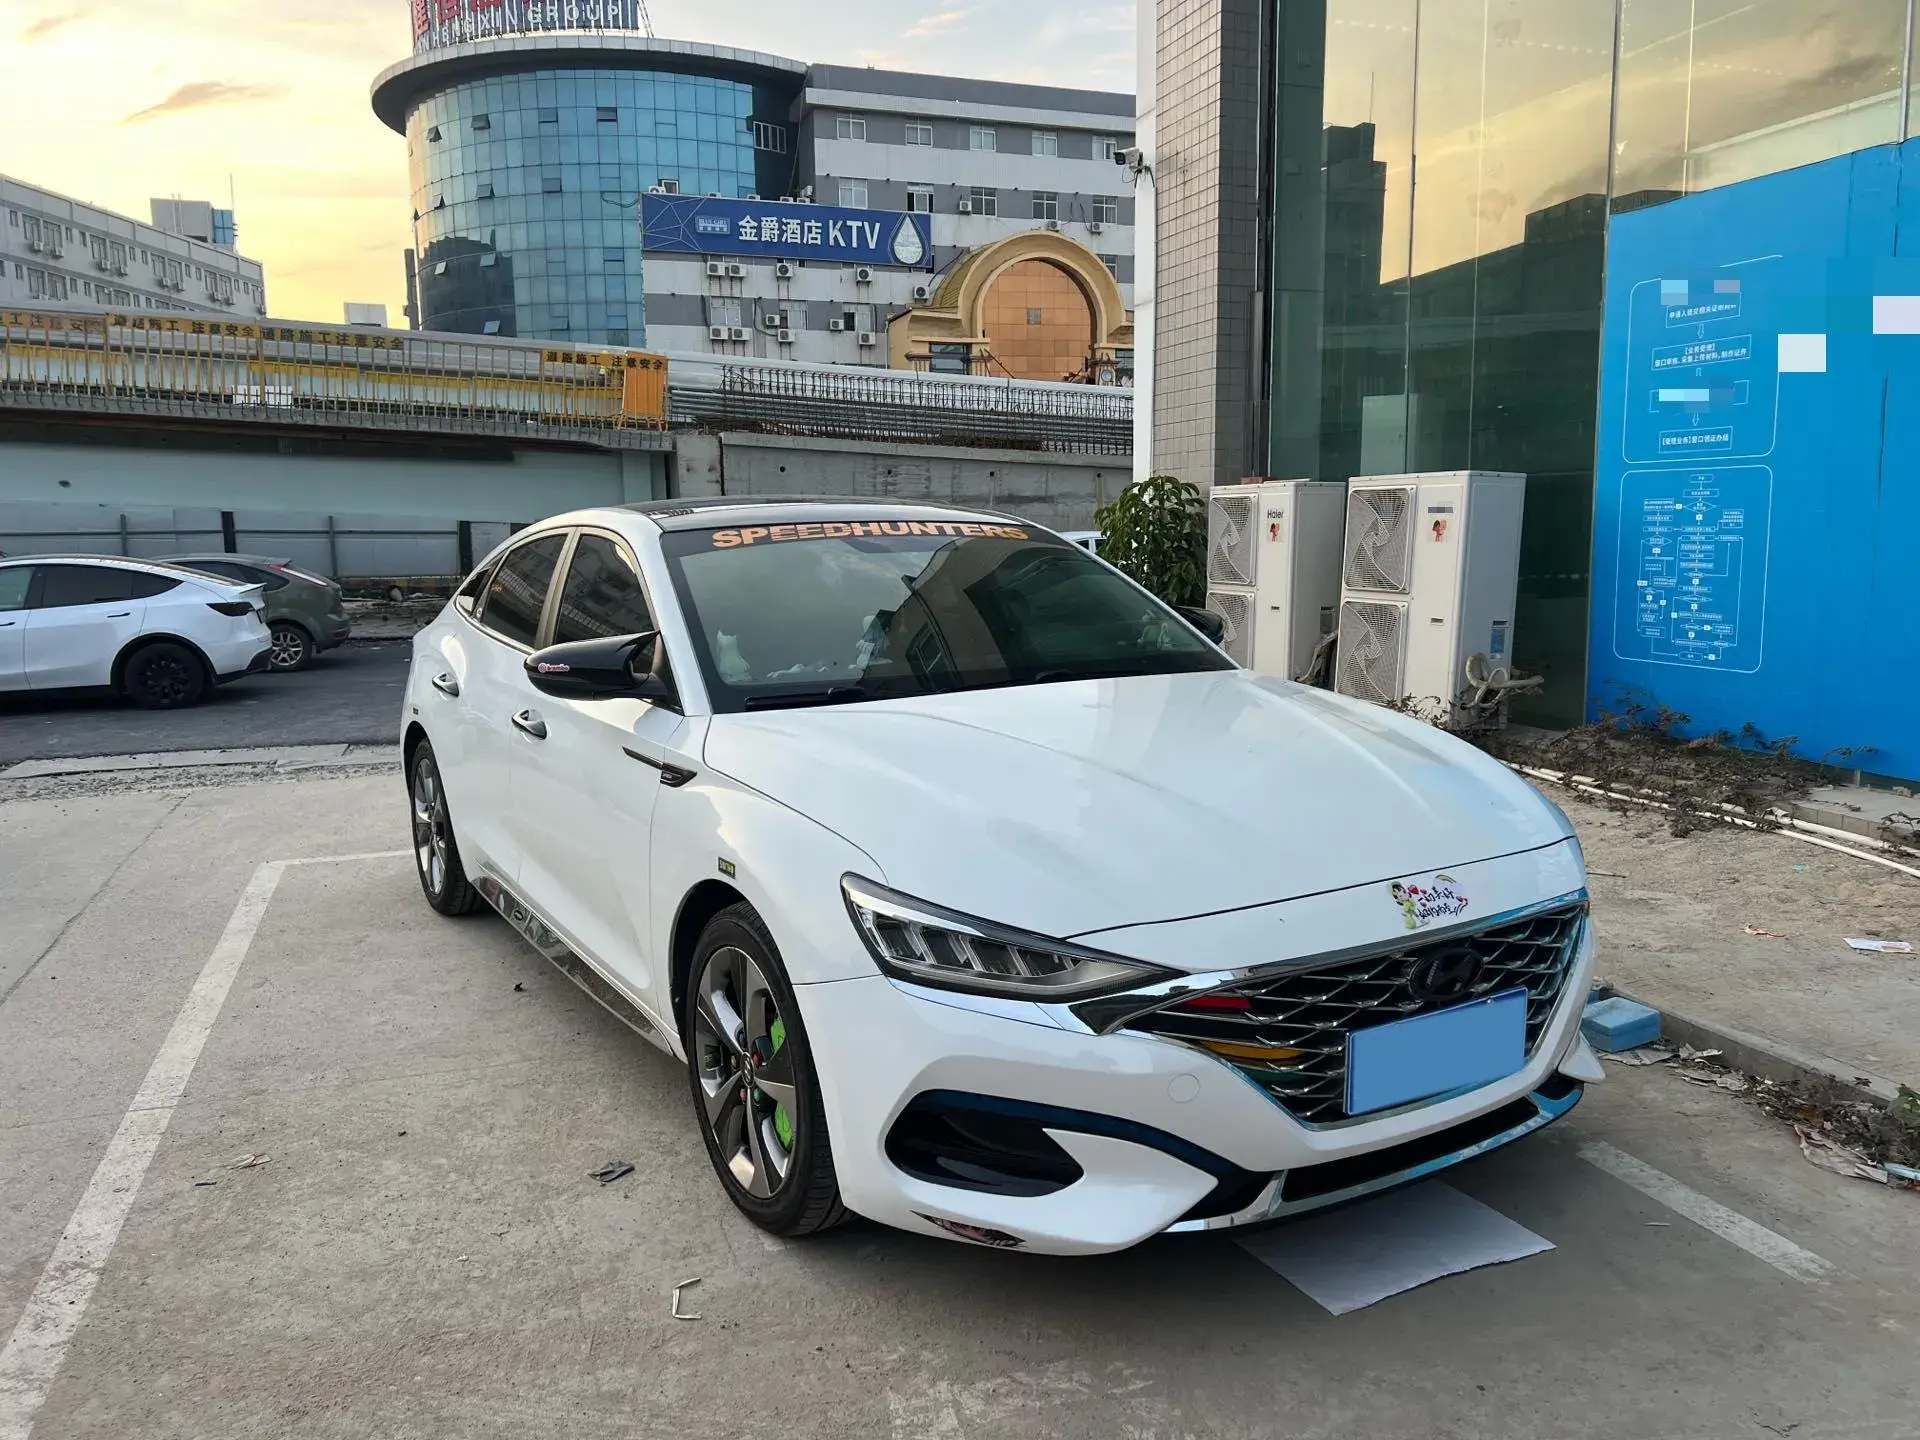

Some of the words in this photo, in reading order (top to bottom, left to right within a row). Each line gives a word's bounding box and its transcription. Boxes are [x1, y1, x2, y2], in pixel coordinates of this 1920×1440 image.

[737, 214, 821, 245] 金爵酒店
[829, 220, 880, 249] KTV
[1267, 509, 1284, 518] Haier
[711, 521, 1030, 548] SPEEDHUNTERS
